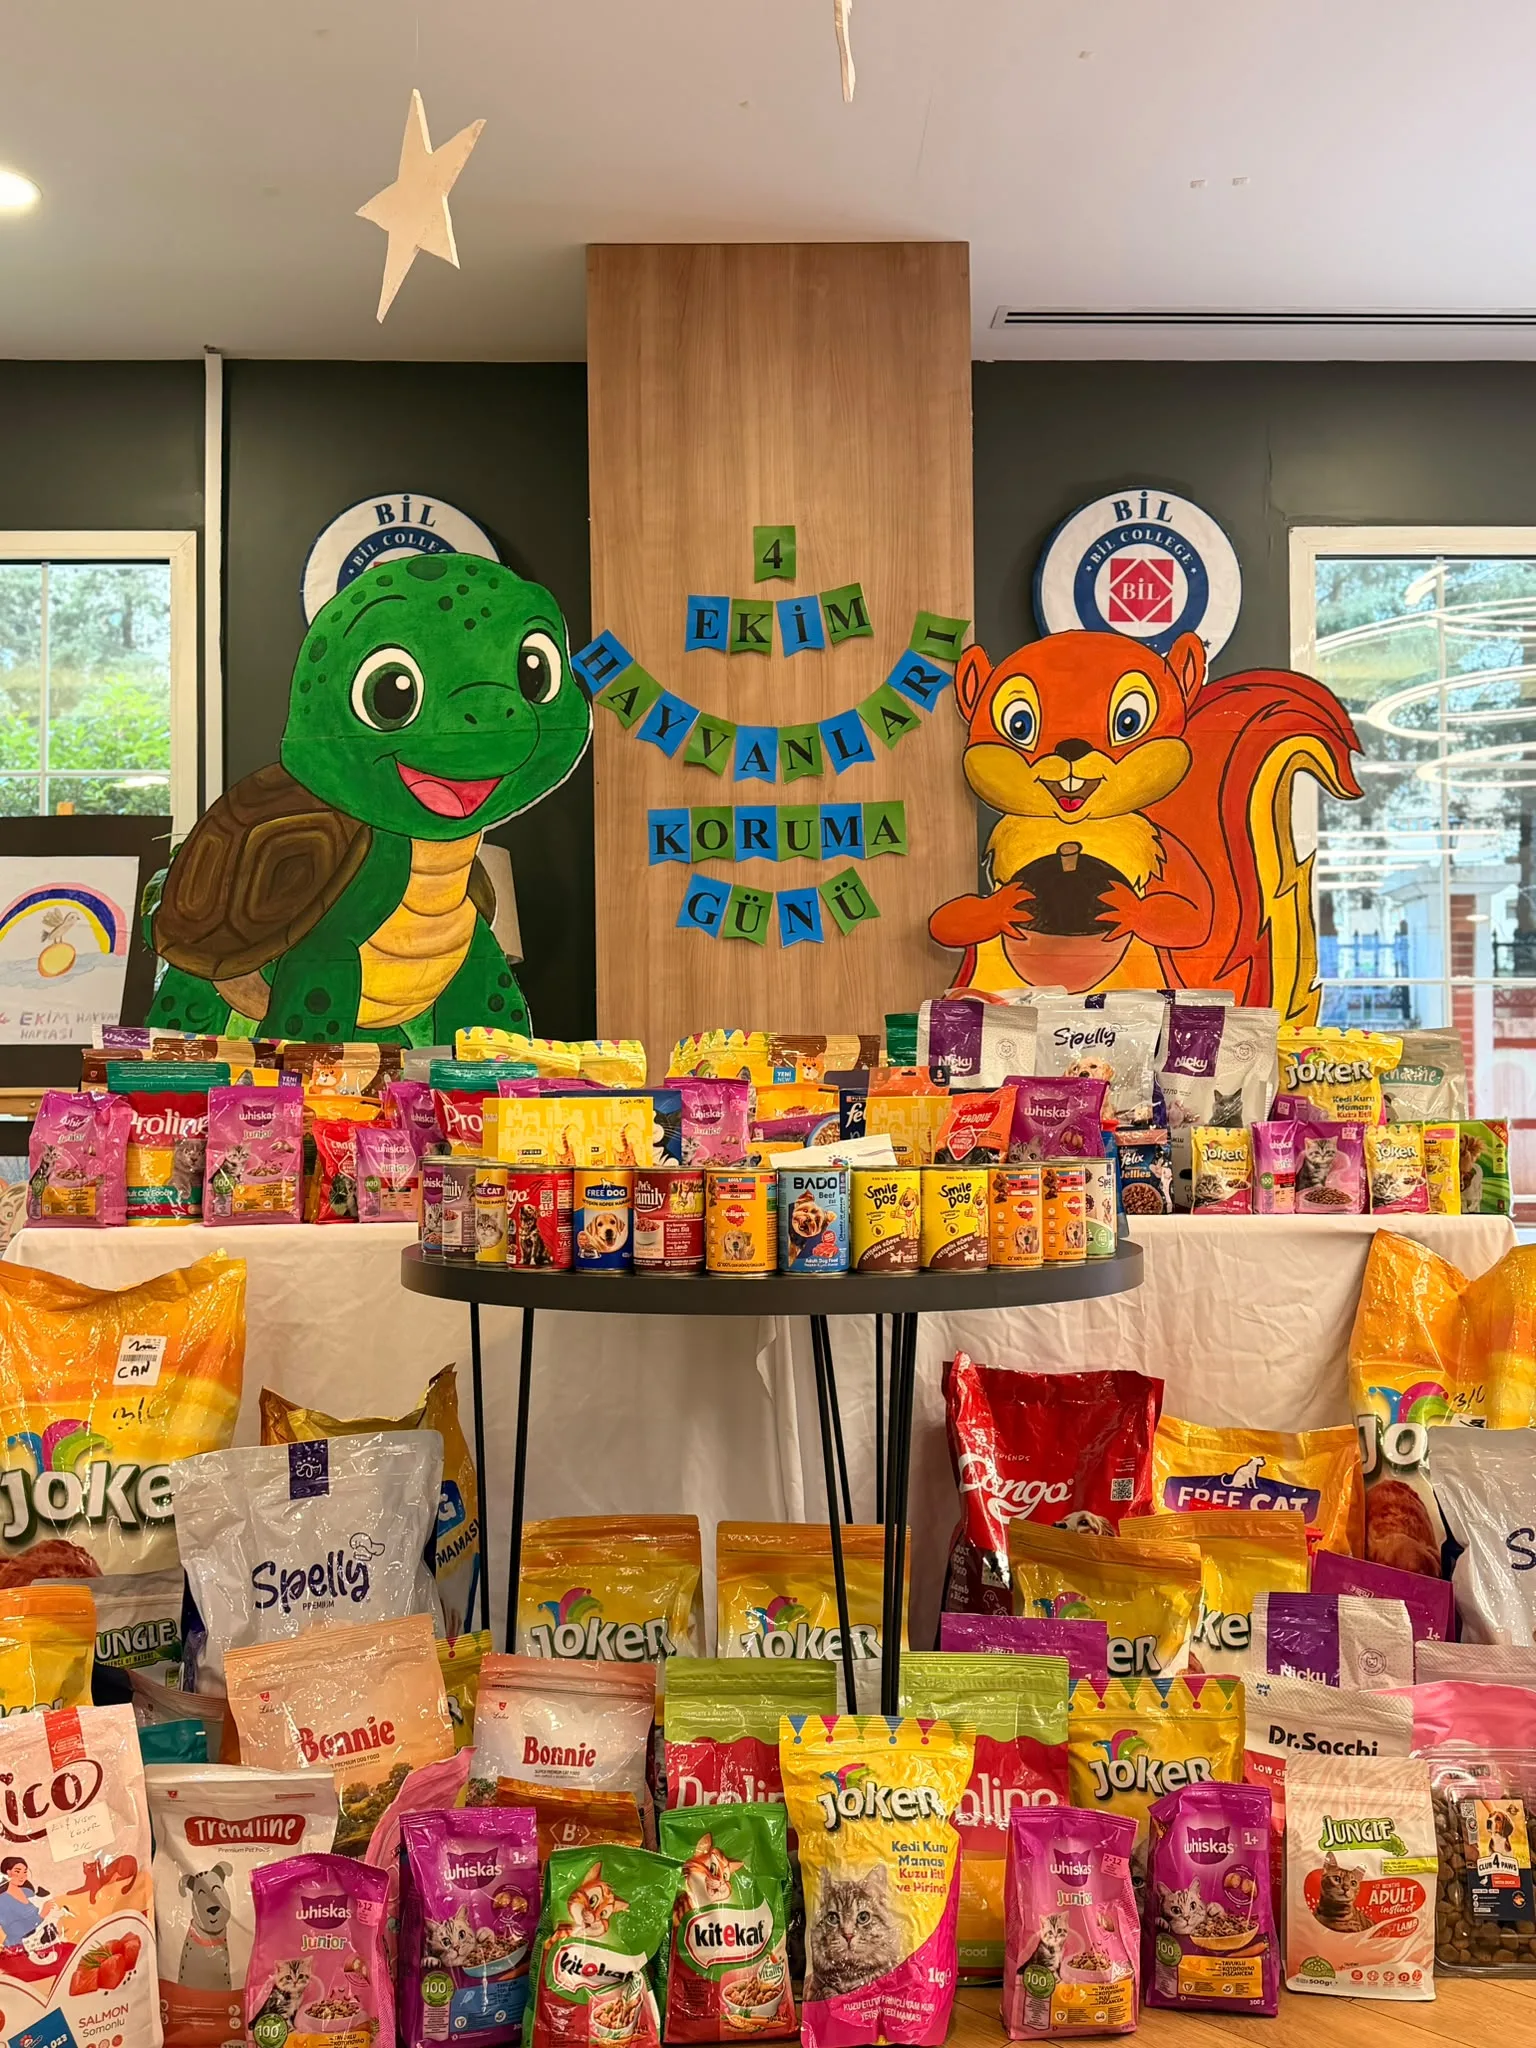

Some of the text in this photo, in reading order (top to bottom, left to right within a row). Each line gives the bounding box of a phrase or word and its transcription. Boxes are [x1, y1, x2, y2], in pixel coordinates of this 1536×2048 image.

[373, 495, 437, 527] BİL
[1112, 491, 1173, 523] BİL
[352, 532, 448, 567] BİL COLLE
[762, 539, 784, 570] 4
[1090, 529, 1194, 565] BİL COLLEGE
[1121, 577, 1161, 601] BİL
[692, 595, 870, 645] EKİM
[580, 625, 958, 773] HAYVANLARI
[653, 815, 902, 857] KORUMA
[687, 881, 868, 935] GÜNÜ
[239, 1110, 277, 1122] whiskas
[1023, 1101, 1072, 1120] whiskas
[375, 1143, 410, 1154] whiskas
[793, 1177, 838, 1190] BADO
[1120, 1170, 1151, 1179] Jellies
[486, 1187, 502, 1195] CAT
[586, 1188, 626, 1197] FREE DOG
[864, 1182, 899, 1199] Smile
[938, 1182, 972, 1198] Smile
[117, 1360, 150, 1379] CAN
[251, 1549, 370, 1614] Spelly
[96, 1621, 174, 1660] UNGLE
[299, 1715, 396, 1763] Bonnie
[522, 1736, 597, 1768] Bonnie
[194, 1818, 297, 1841] Trendline
[891, 1840, 920, 1853] Kedi
[1183, 1830, 1236, 1855] whiskas
[1244, 1832, 1260, 1847] 1+
[512, 1851, 528, 1864] 1+
[1103, 1853, 1122, 1866] 2-12
[1500, 1862, 1517, 1872] PAWS
[443, 1860, 503, 1881] whiskas
[899, 1867, 928, 1879] Kuzu
[1050, 1860, 1092, 1876] whiskas
[1368, 1884, 1418, 1906] ADULT
[295, 1903, 352, 1920] whiskas
[301, 1934, 348, 1952] Junior
[694, 1920, 764, 1948] kitekat
[958, 1946, 988, 1958] Food
[424, 1980, 448, 1994] 100
[1025, 1970, 1047, 1988] 100
[77, 2002, 130, 2030] SALMON
[82, 2017, 126, 2039] Somonlu
[258, 2024, 280, 2038] 100
